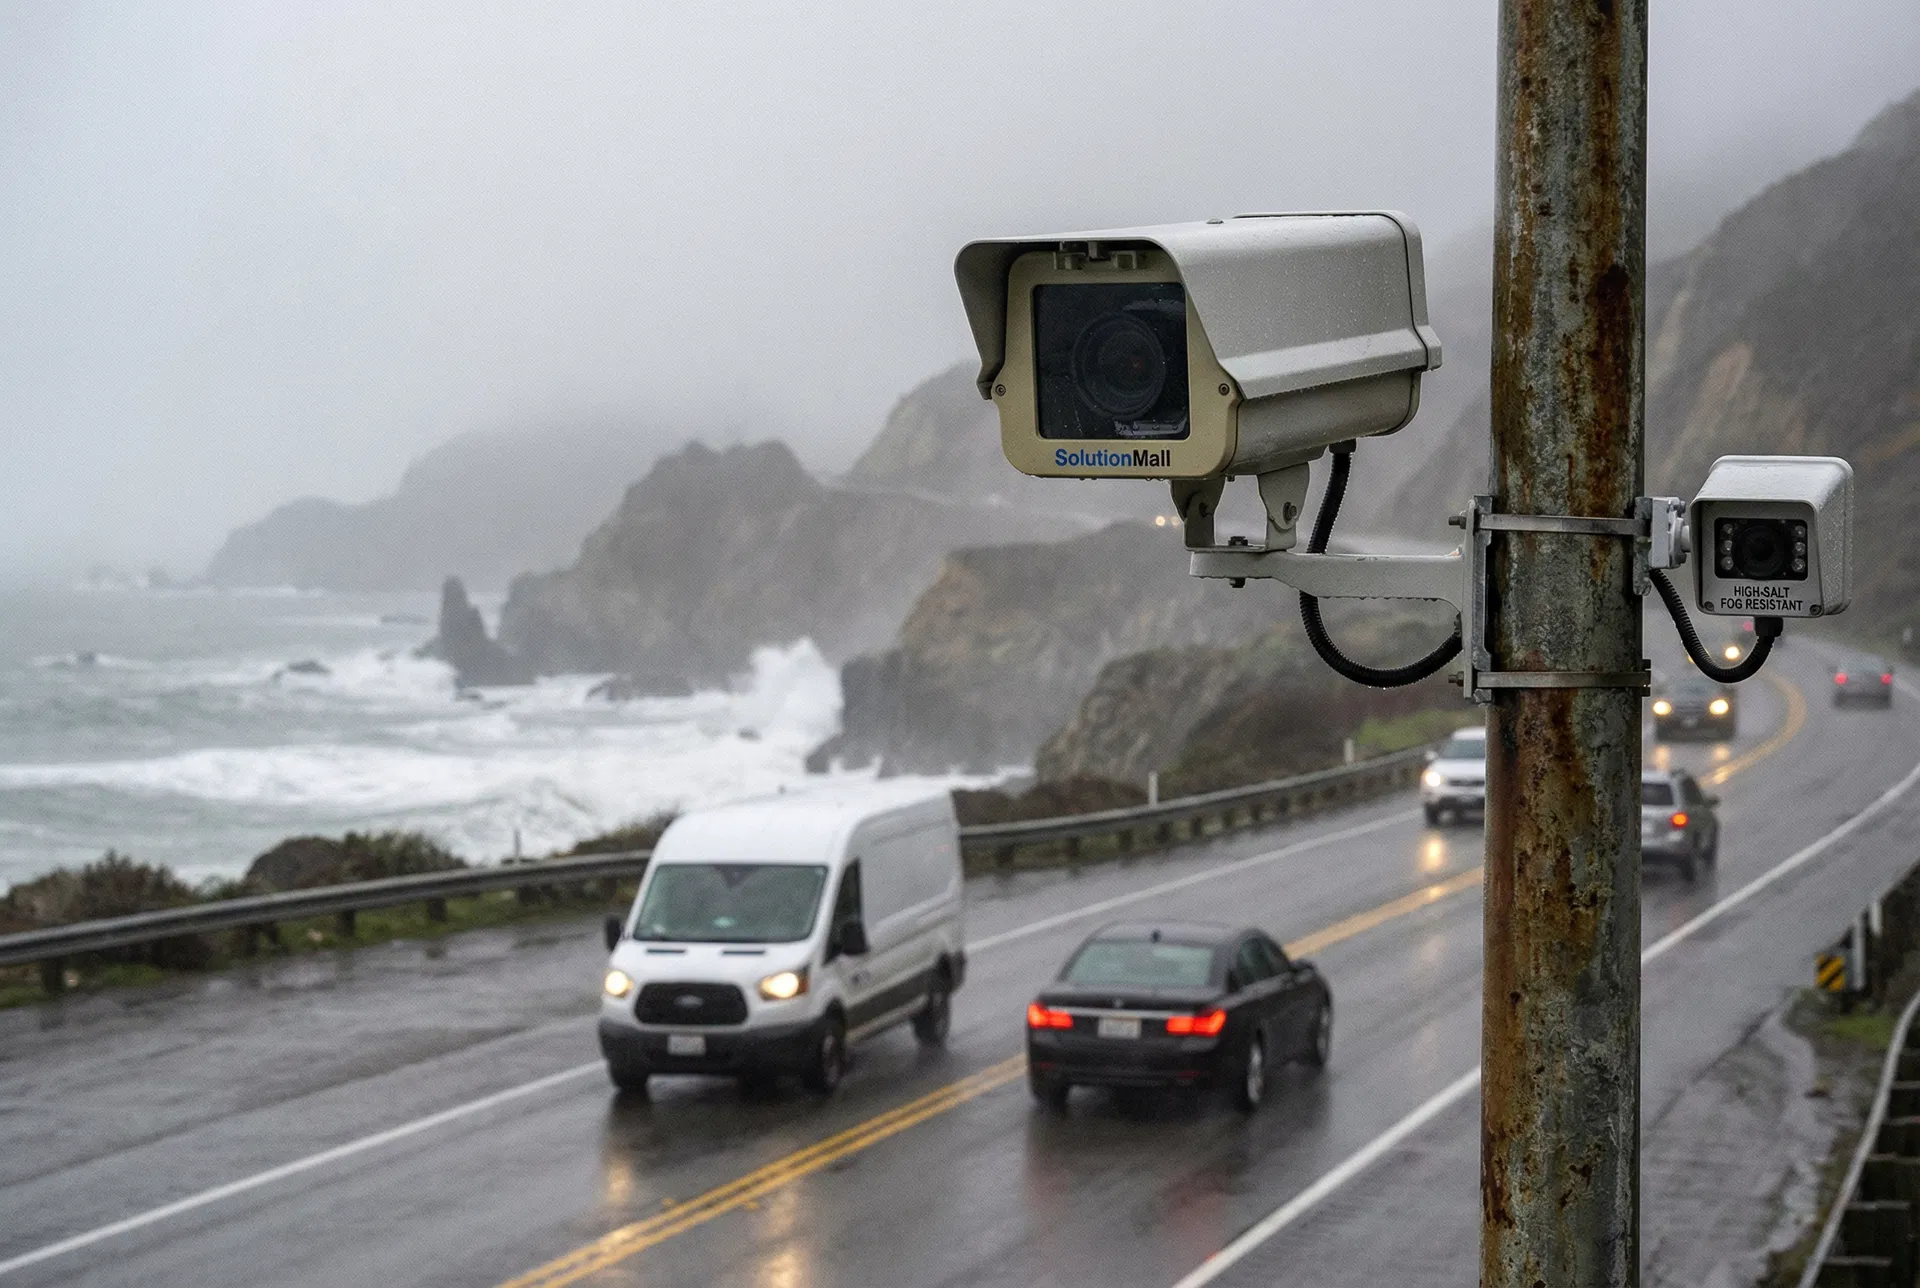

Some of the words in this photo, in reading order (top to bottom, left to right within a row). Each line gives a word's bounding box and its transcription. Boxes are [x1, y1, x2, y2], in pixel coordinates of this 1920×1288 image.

[1055, 448, 1170, 467] SolutionMall
[1721, 598, 1742, 609] FOG
[1745, 598, 1803, 611] RESISTANT
